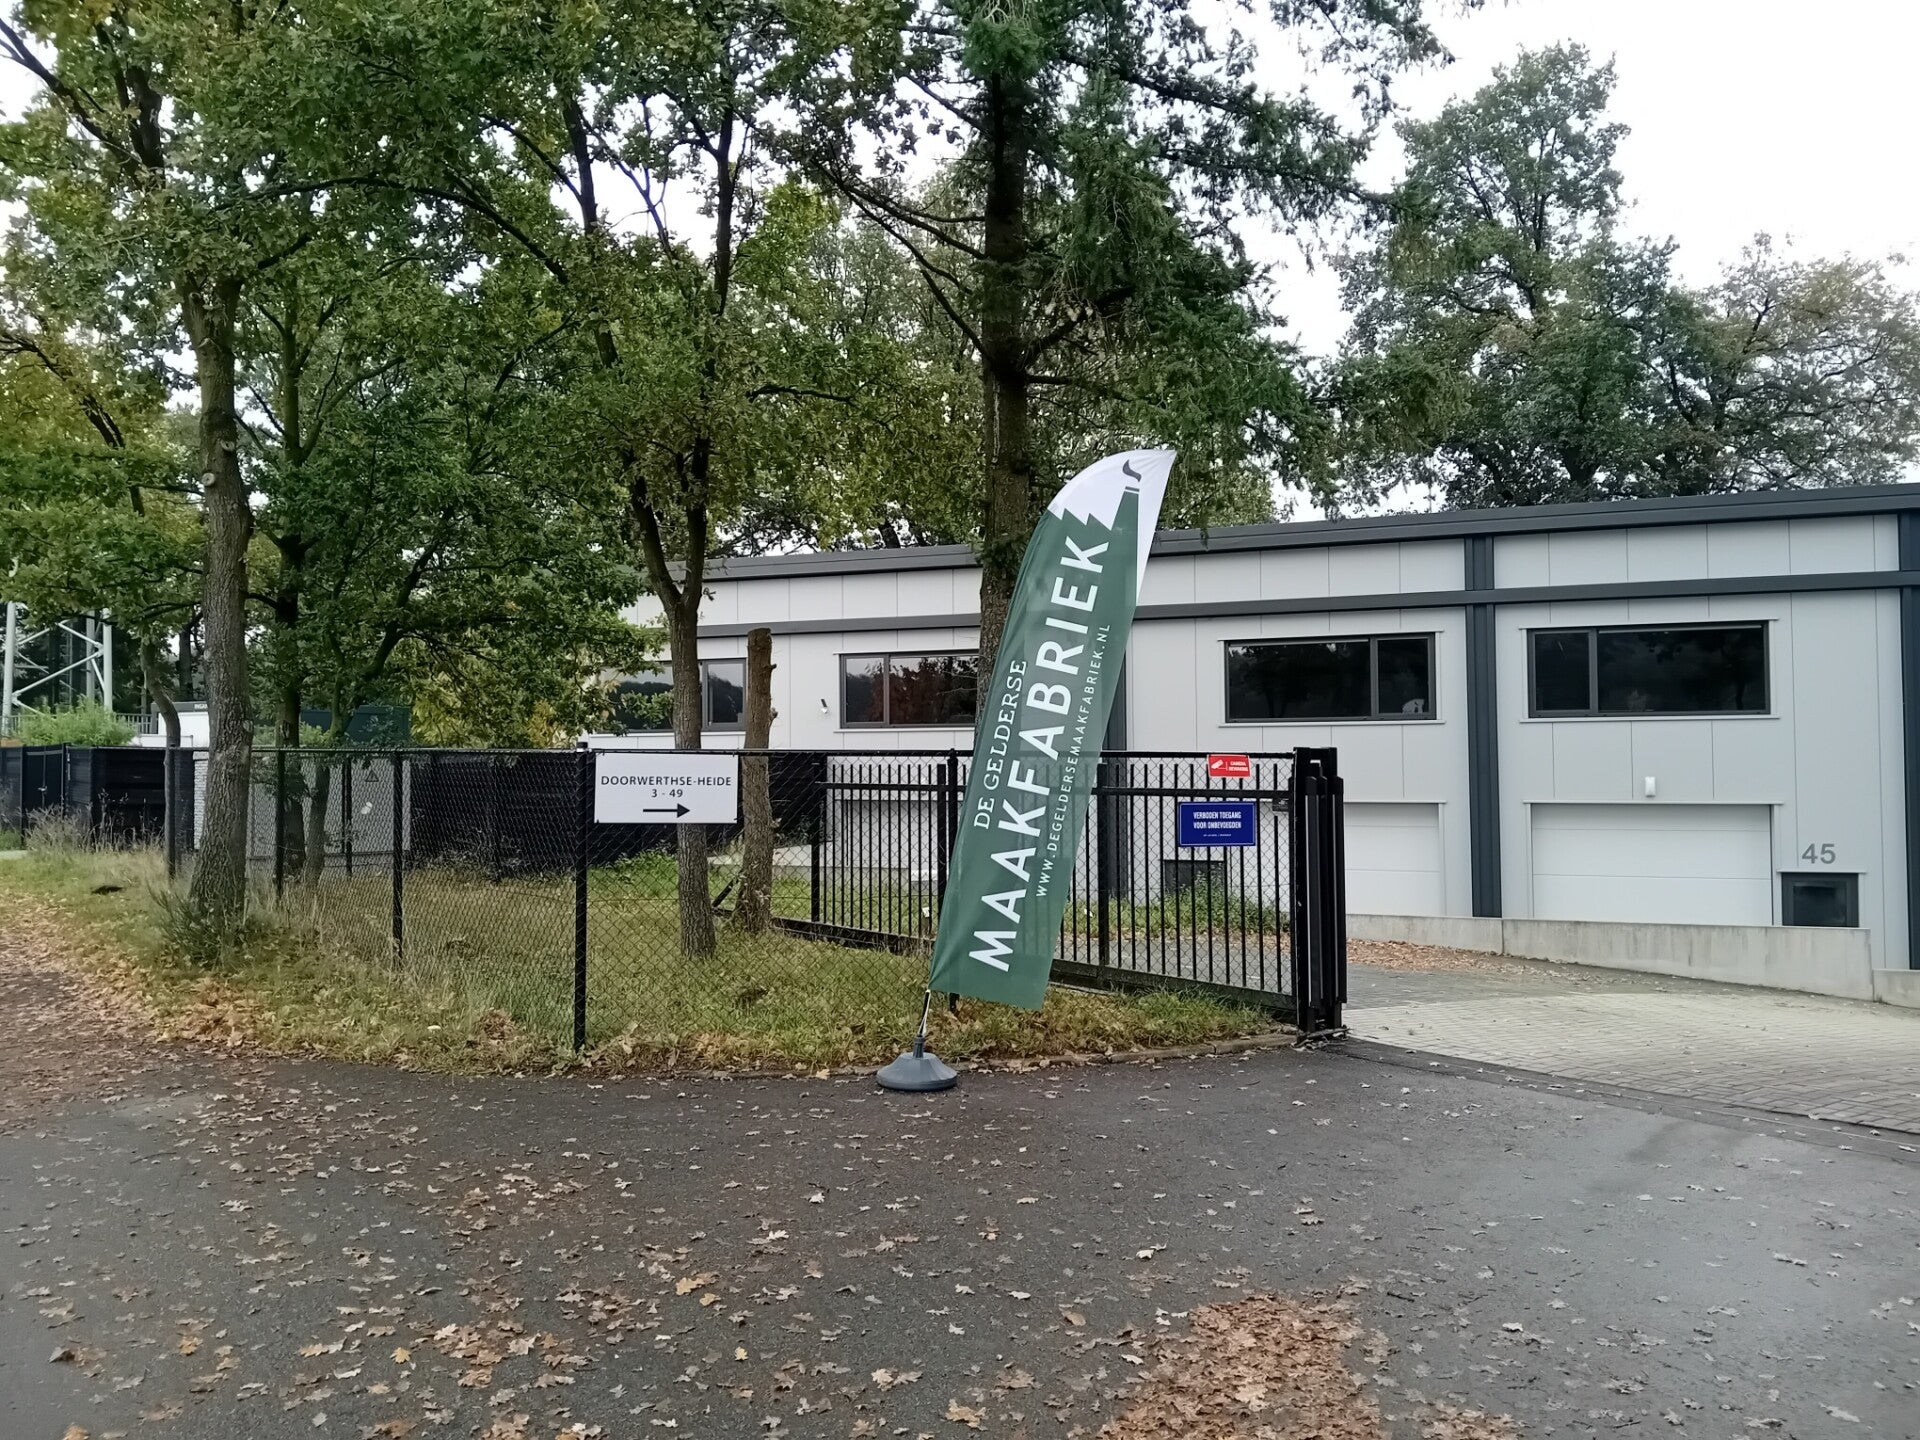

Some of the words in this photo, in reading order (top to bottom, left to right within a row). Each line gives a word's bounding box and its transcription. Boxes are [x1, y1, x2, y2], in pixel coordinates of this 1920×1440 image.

[983, 659, 1027, 791] GELDERSE
[968, 535, 1110, 973] MAAKFABRIEK
[1035, 624, 1111, 898] WWW.DEGELDERSEMAAKFABRIEK.NL
[601, 775, 731, 786] DOORWERTHSE-HEIDE
[651, 788, 658, 798] 3
[669, 788, 683, 798] 49
[973, 797, 995, 830] DE
[1193, 811, 1218, 819] VERBODEN
[1219, 811, 1242, 819] TOEGANG
[1193, 821, 1207, 829] VOOR
[1207, 821, 1242, 829] ONBEVOEGDEN
[1801, 843, 1836, 864] 45
